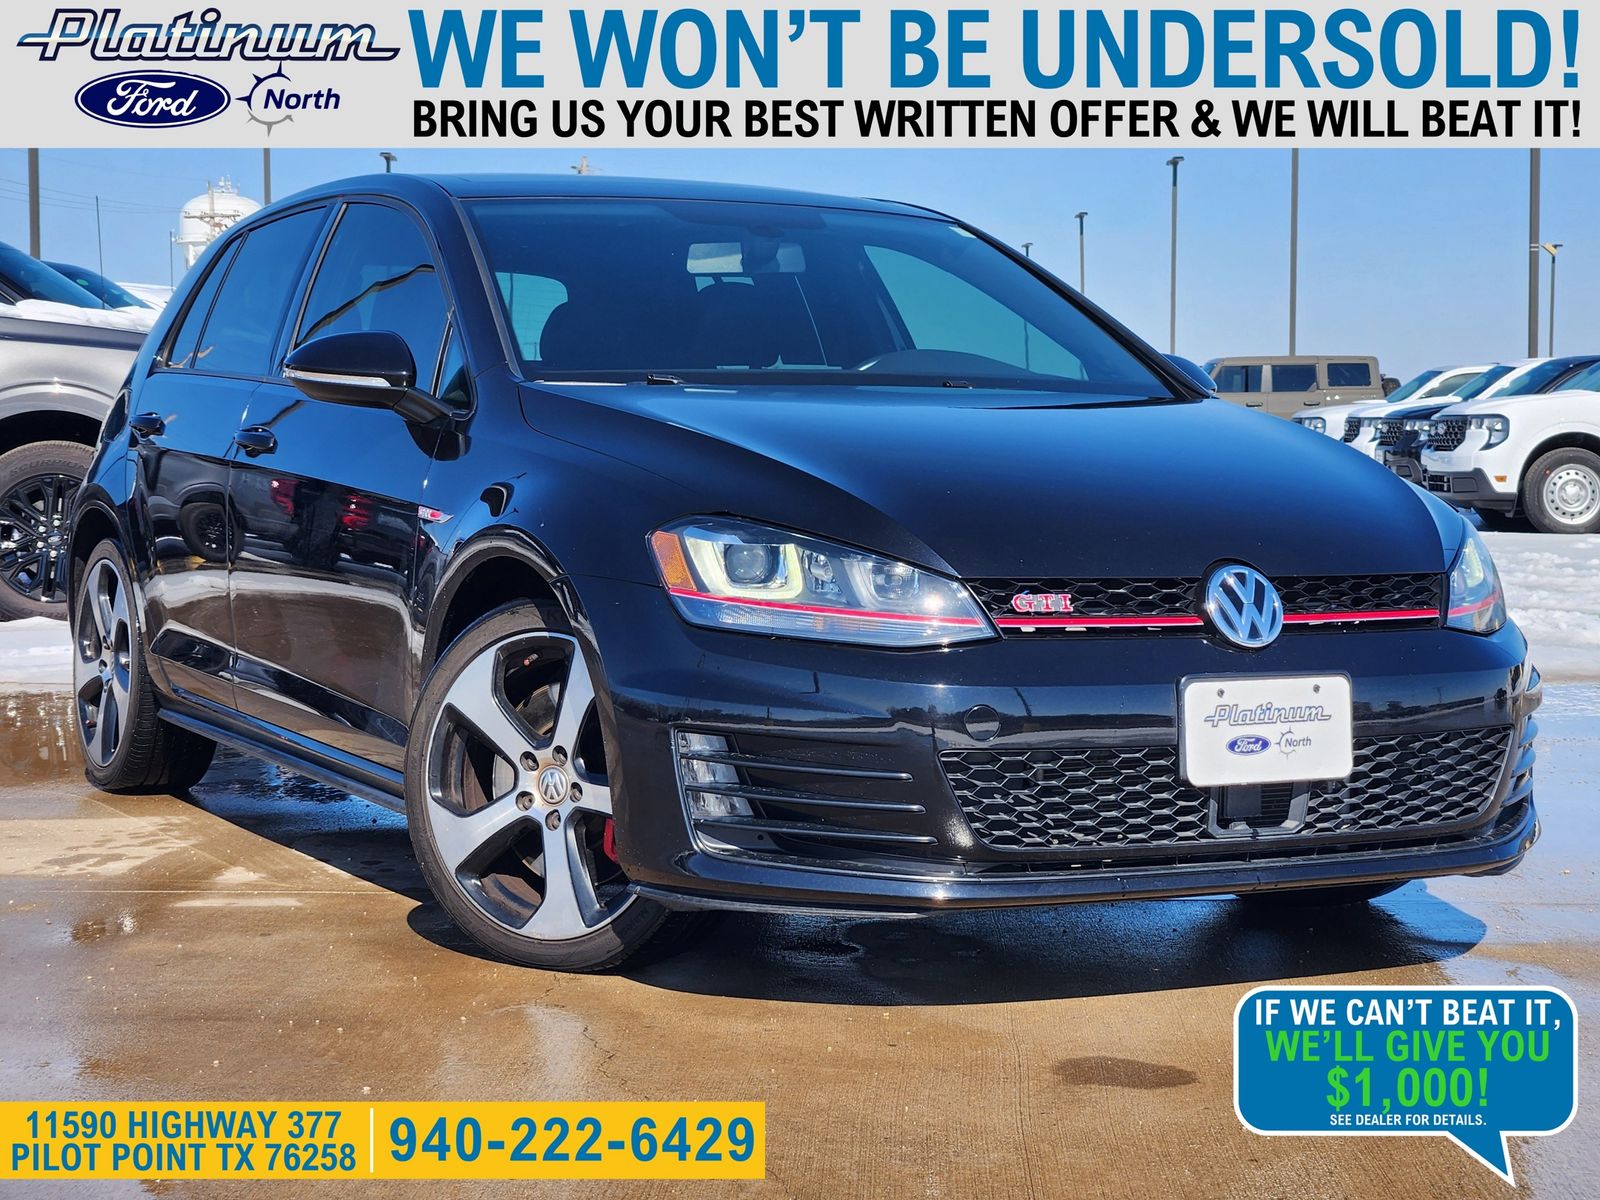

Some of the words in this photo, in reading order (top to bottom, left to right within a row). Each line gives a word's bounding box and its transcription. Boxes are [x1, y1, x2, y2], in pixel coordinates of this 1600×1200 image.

[1011, 593, 1074, 612] GTI
[1204, 701, 1332, 728] Platinum
[1284, 736, 1312, 748] North
